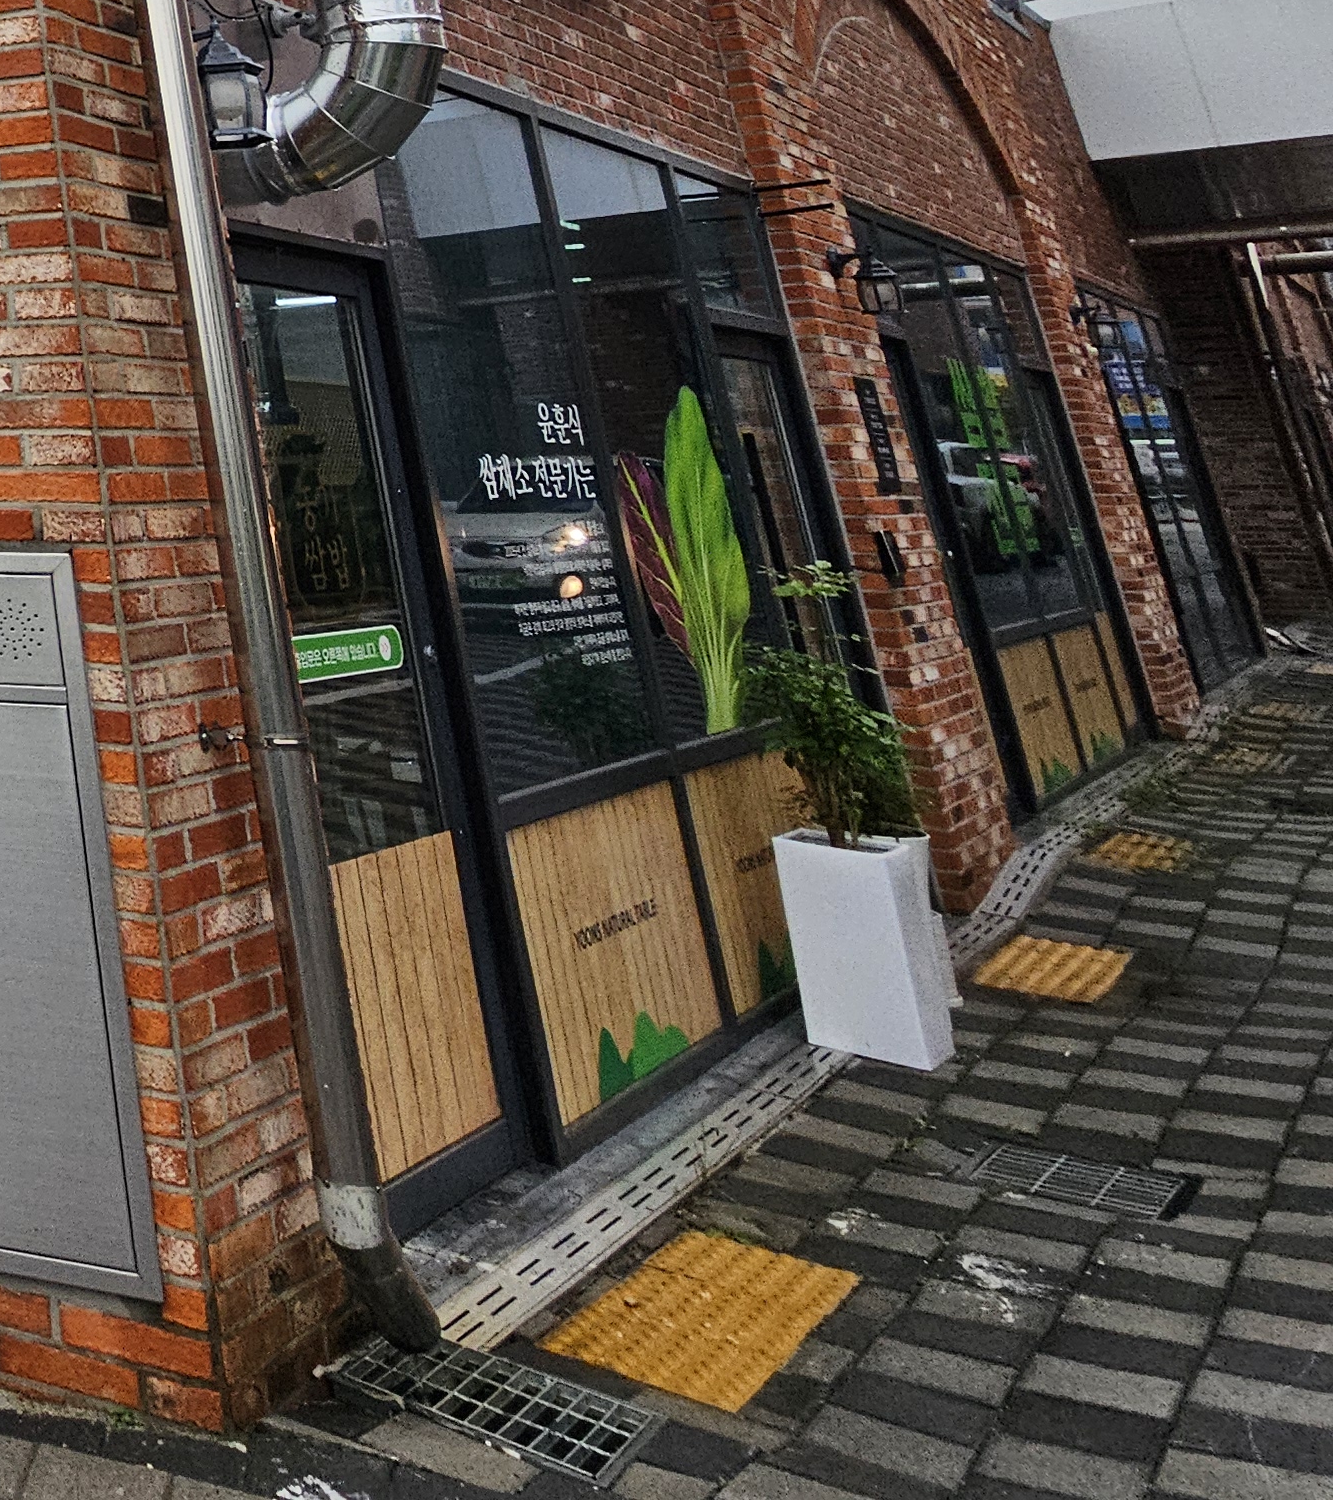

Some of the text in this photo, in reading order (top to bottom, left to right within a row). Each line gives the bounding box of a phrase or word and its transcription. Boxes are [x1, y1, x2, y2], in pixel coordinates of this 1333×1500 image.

[537, 402, 584, 446] 윤훈식
[478, 453, 597, 501] 쌈채소 전문가는
